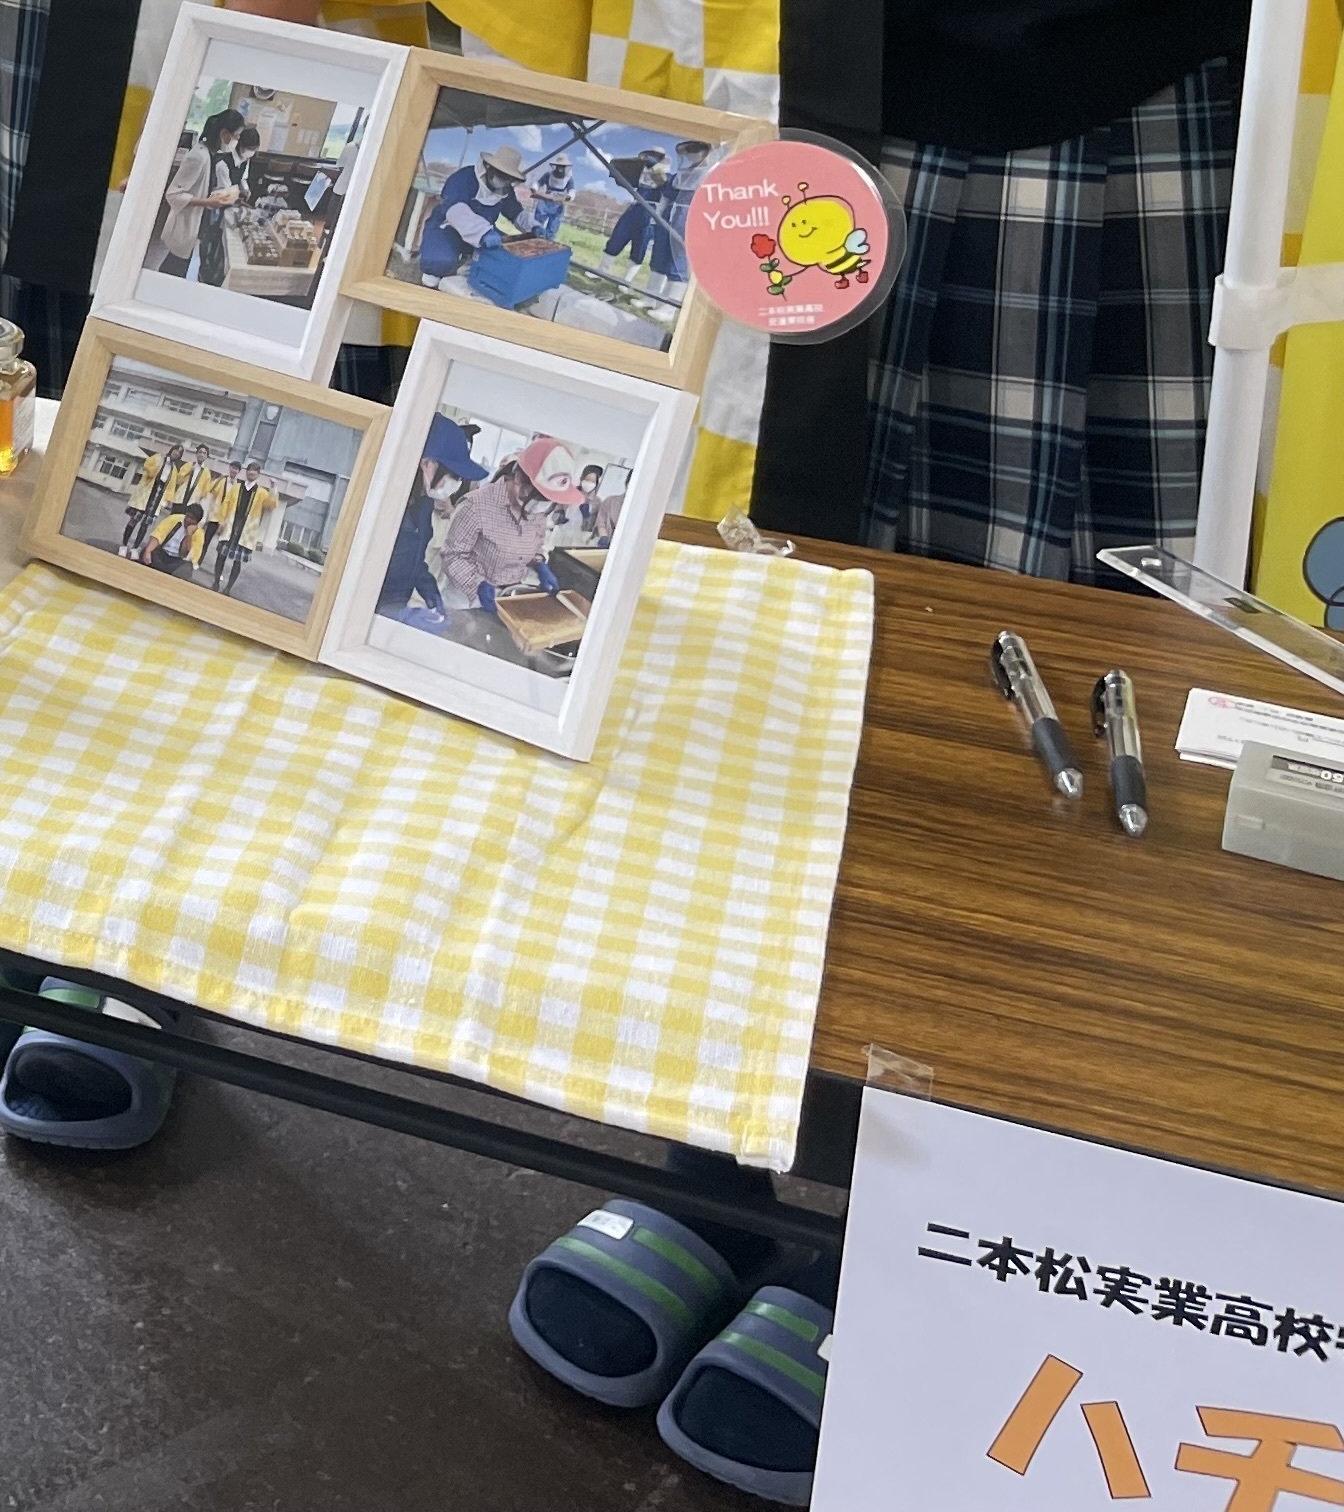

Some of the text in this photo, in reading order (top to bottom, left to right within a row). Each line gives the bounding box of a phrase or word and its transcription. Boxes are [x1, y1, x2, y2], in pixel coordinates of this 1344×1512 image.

[700, 178, 780, 204] Thank
[703, 206, 771, 232] You!!!
[916, 1221, 1344, 1364] 二本松実業高校
